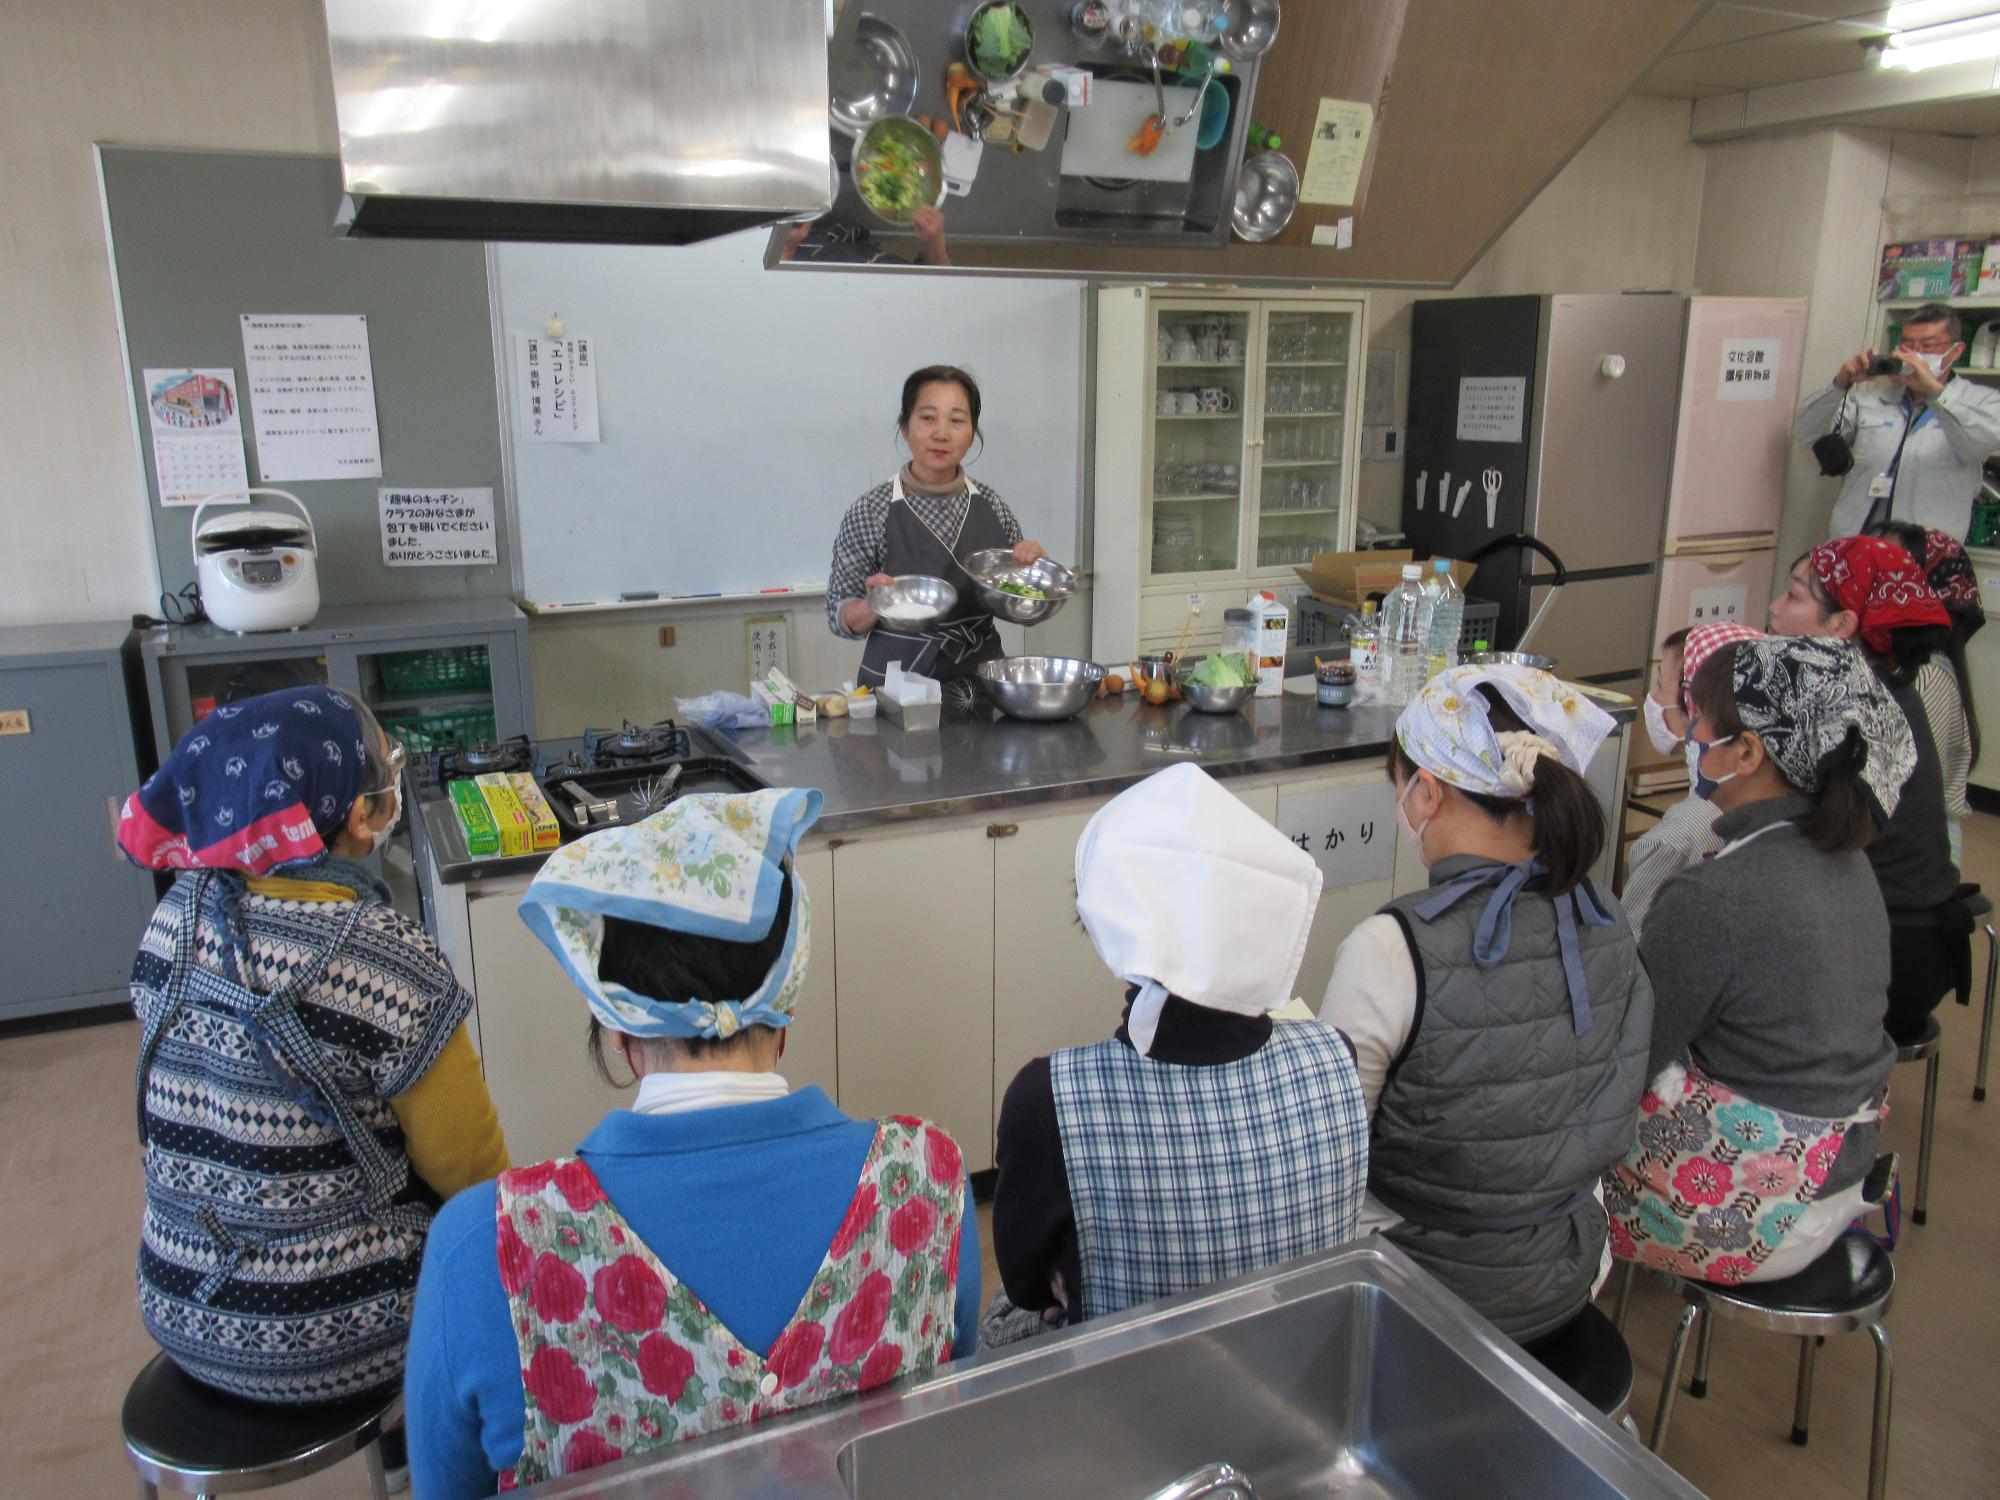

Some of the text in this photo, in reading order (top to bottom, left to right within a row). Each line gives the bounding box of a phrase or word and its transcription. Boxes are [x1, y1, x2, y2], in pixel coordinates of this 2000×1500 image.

[551, 339, 566, 419] 「エコレシピ」
[386, 521, 490, 533] 包丁を研いでください
[388, 537, 422, 548] ました。
[388, 549, 495, 561] ありがとうございました。
